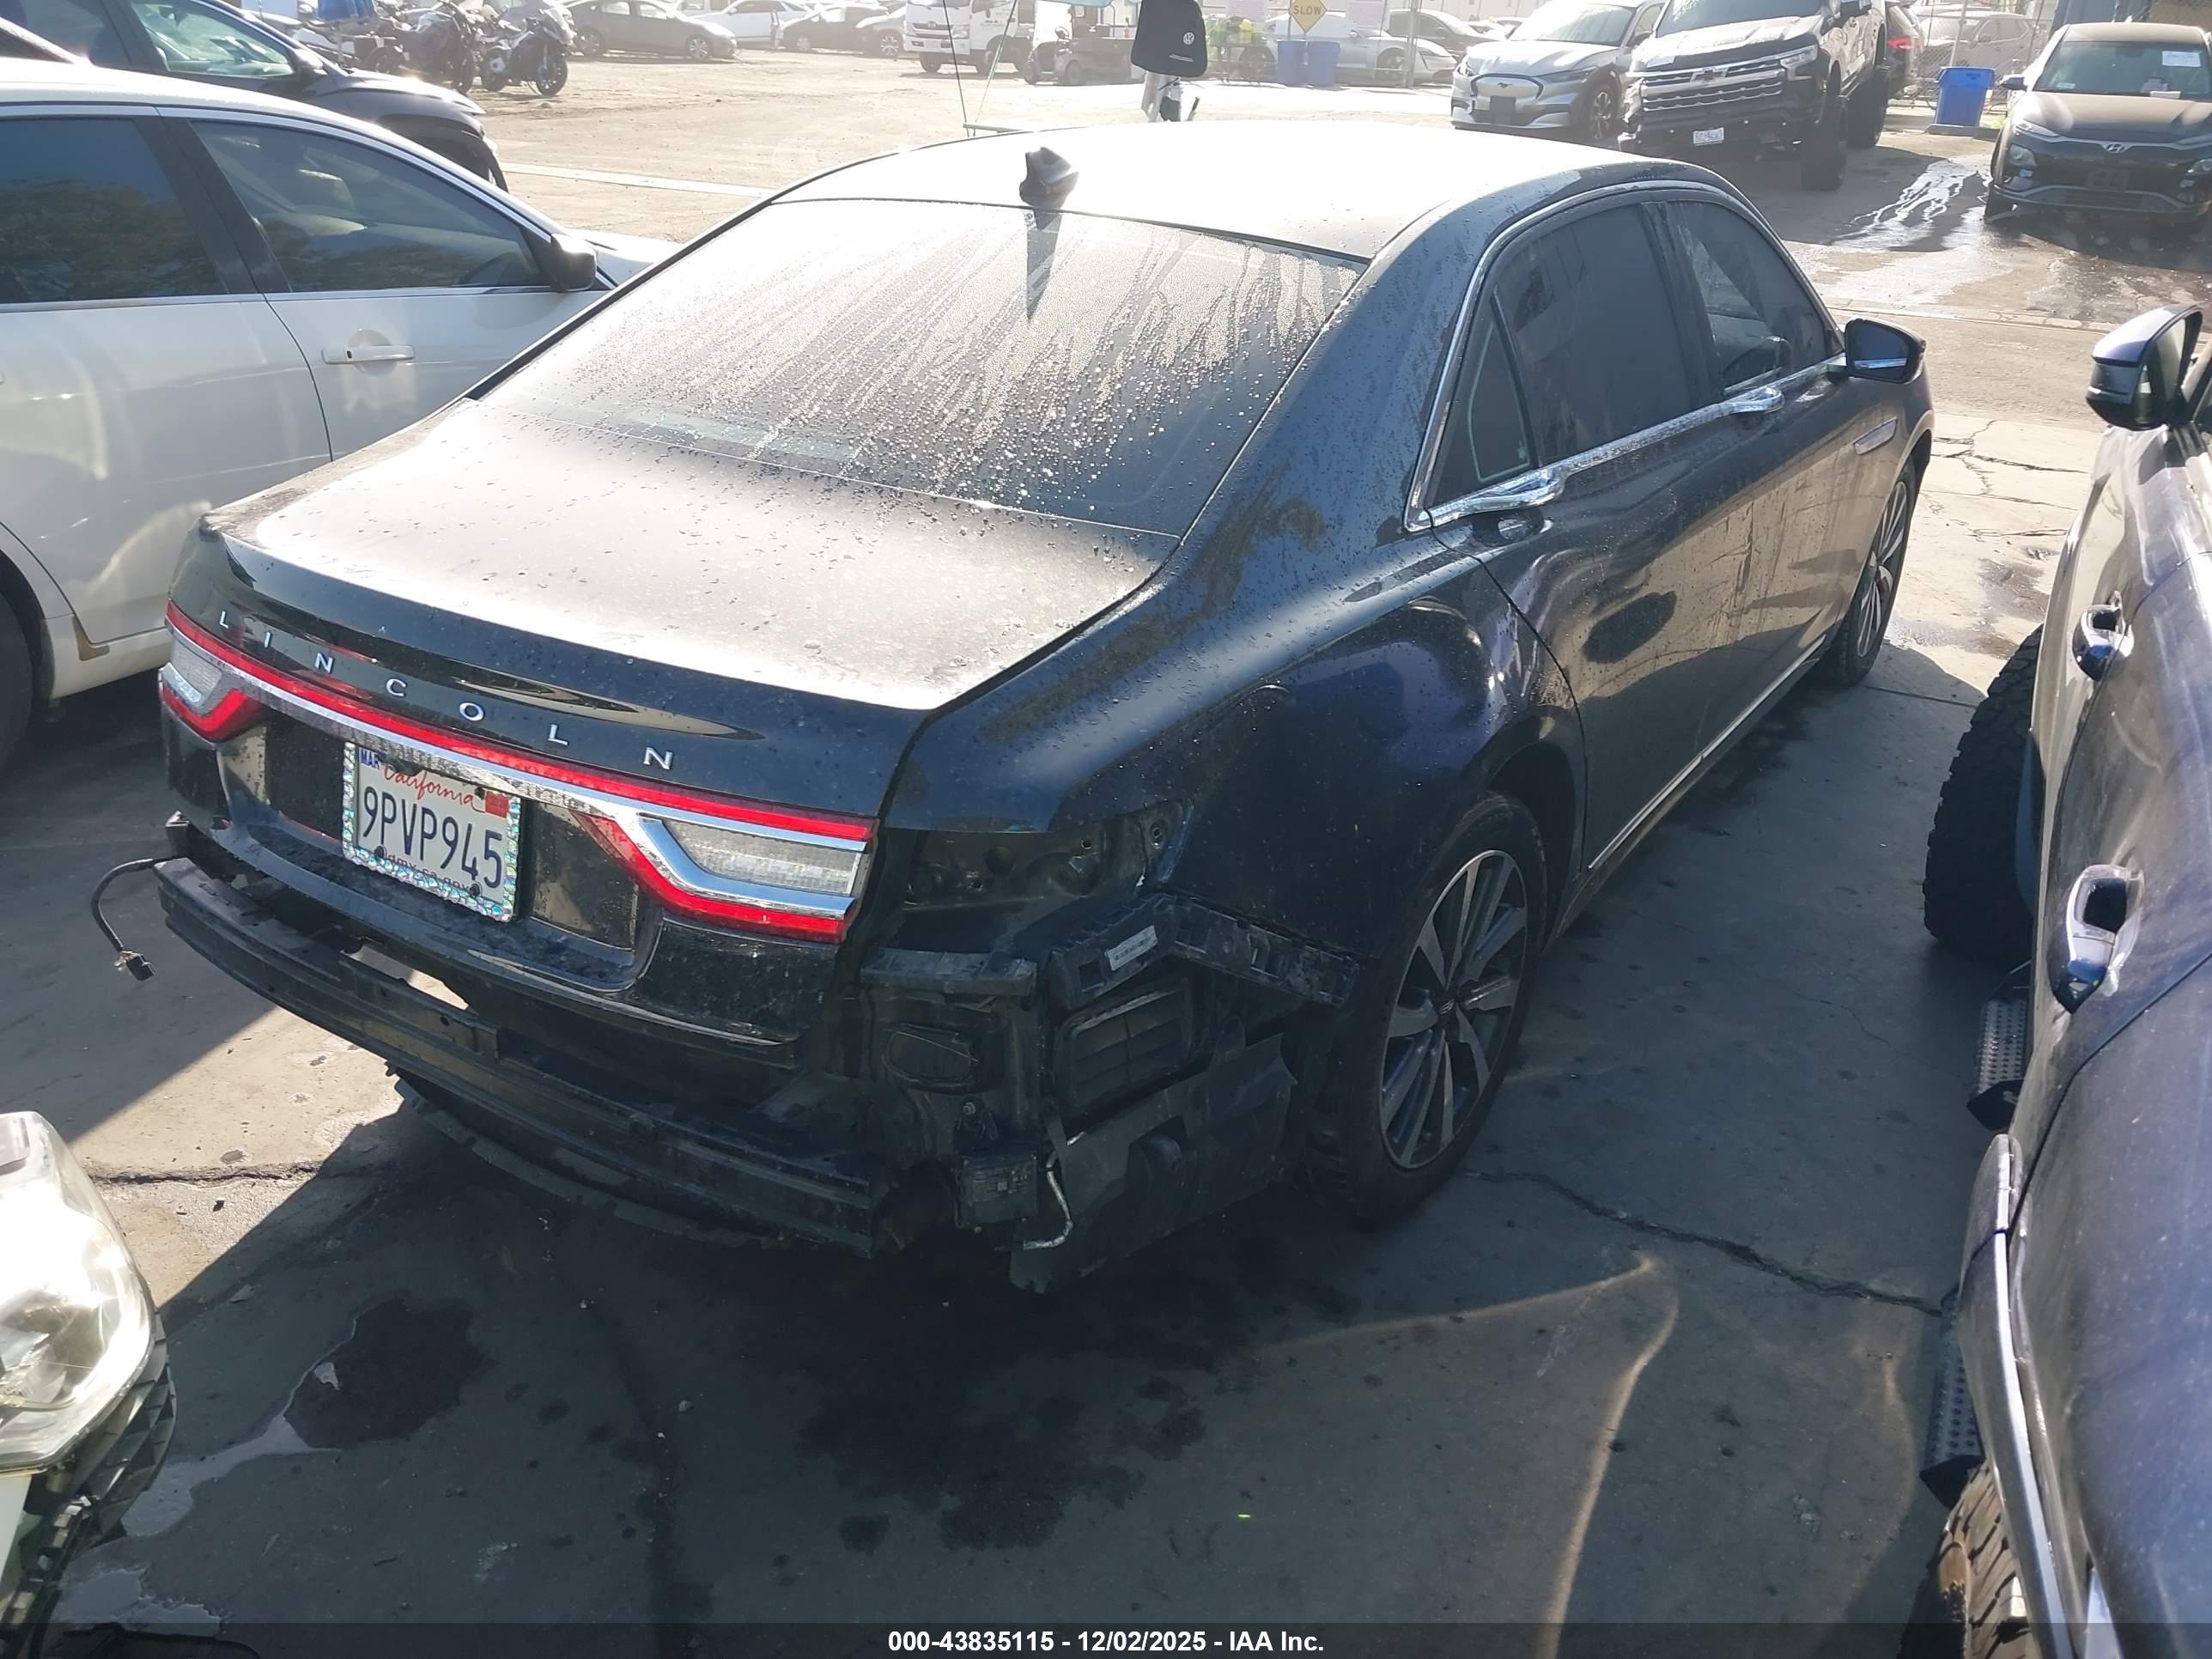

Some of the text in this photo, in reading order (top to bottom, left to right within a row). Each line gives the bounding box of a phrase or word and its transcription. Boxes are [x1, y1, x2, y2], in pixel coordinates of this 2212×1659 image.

[1292, 5, 1322, 15] SLOW
[220, 611, 673, 770] LINCOLN
[362, 786, 503, 890] 9PVP945
[388, 854, 469, 890] dmvcagov
